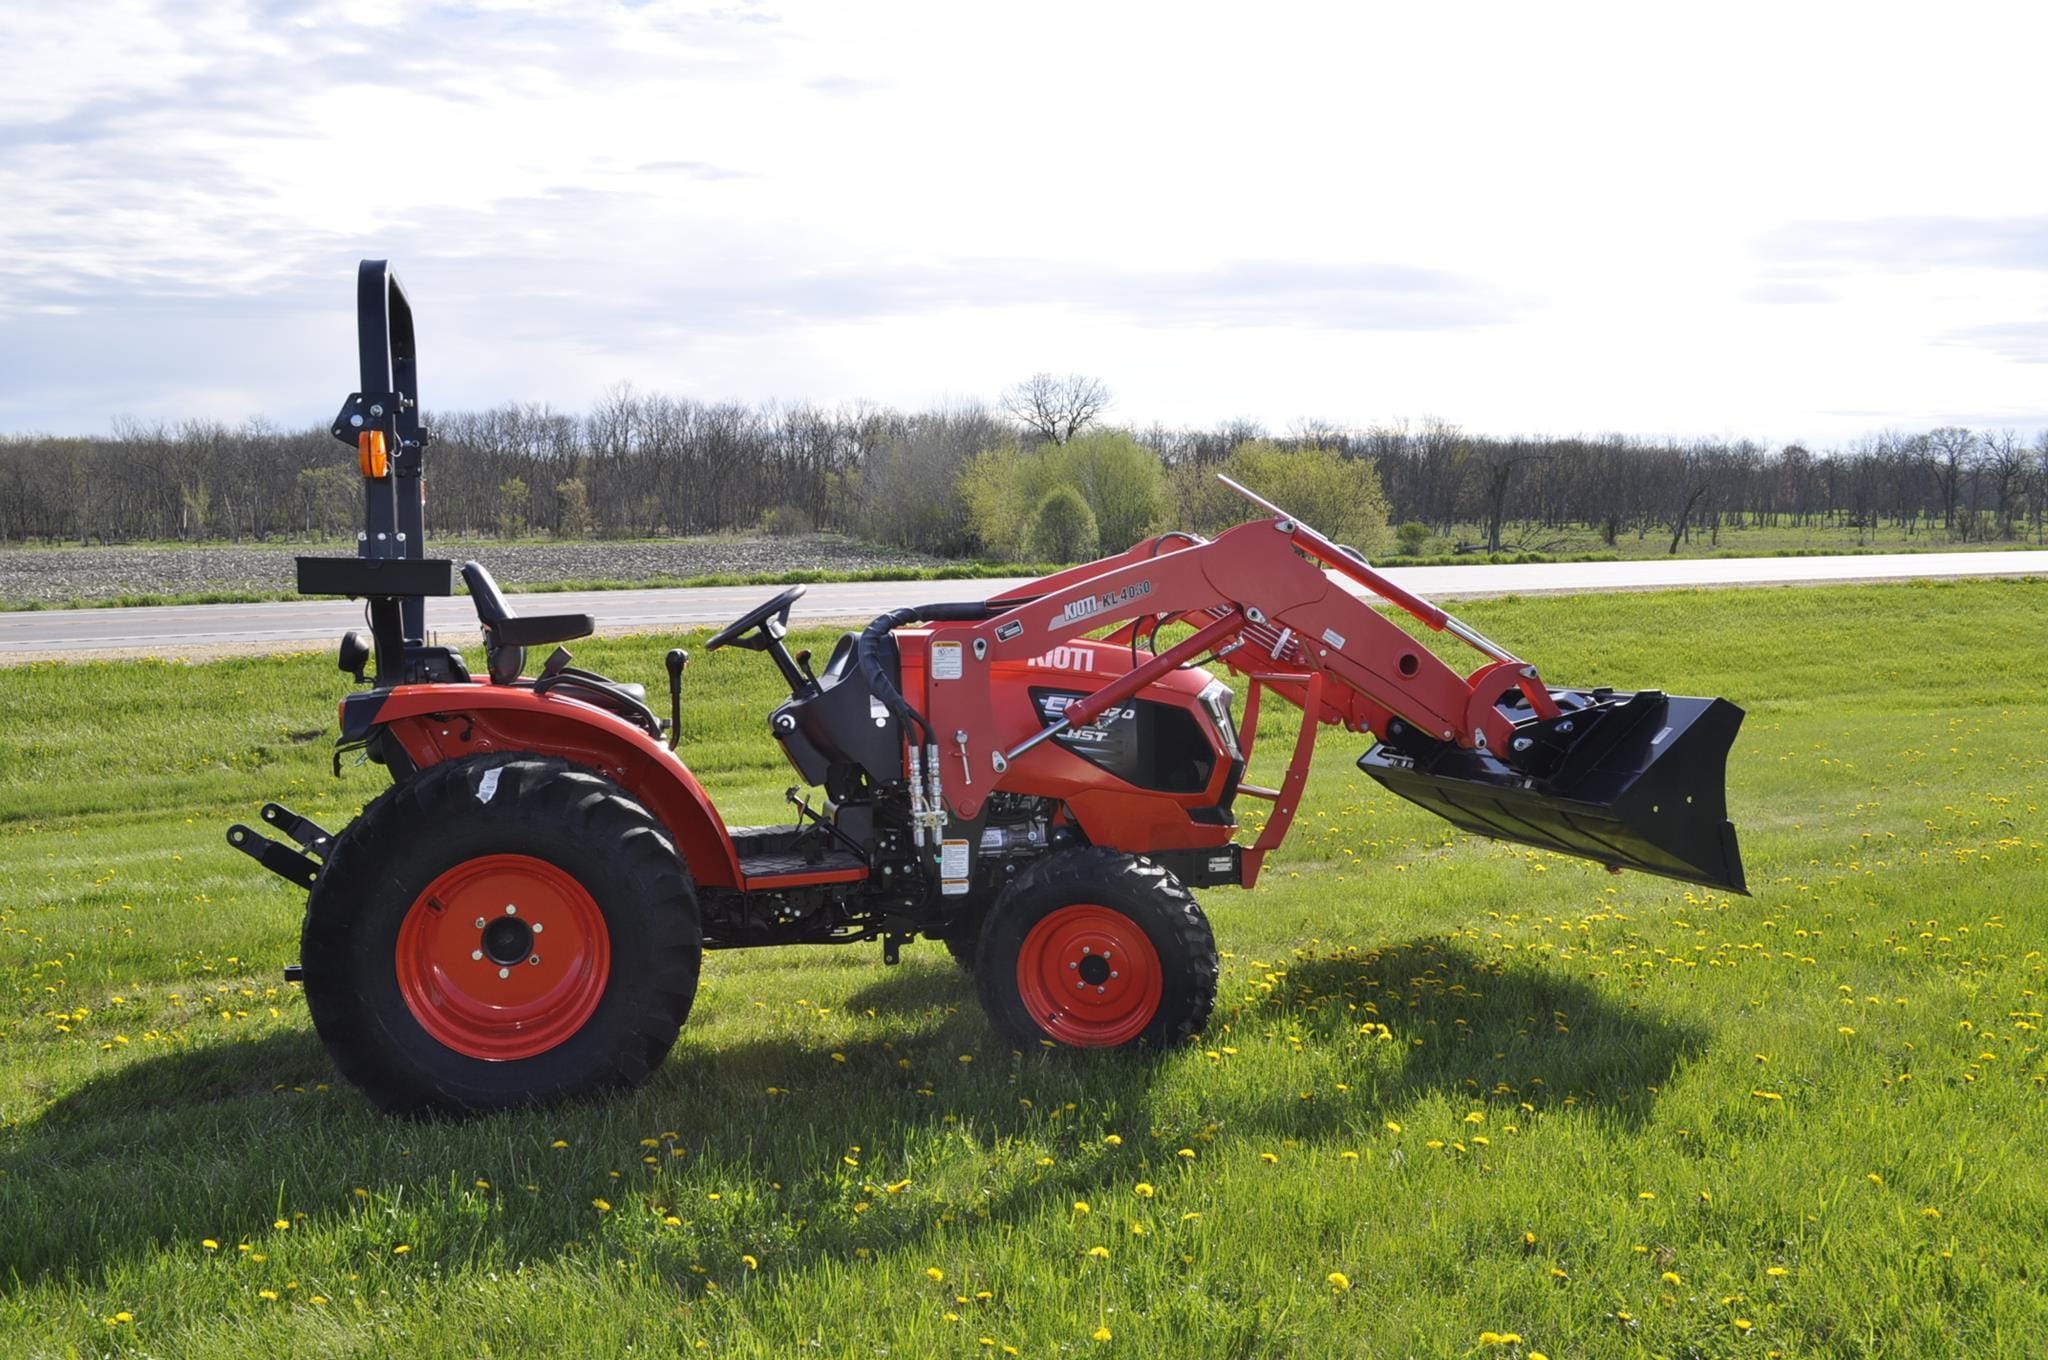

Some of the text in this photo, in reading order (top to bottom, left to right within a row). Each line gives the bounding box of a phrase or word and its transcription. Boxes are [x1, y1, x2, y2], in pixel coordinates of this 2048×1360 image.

[1064, 595, 1097, 620] KIOTI
[1103, 592, 1118, 608] KL
[1066, 729, 1108, 741] HST
